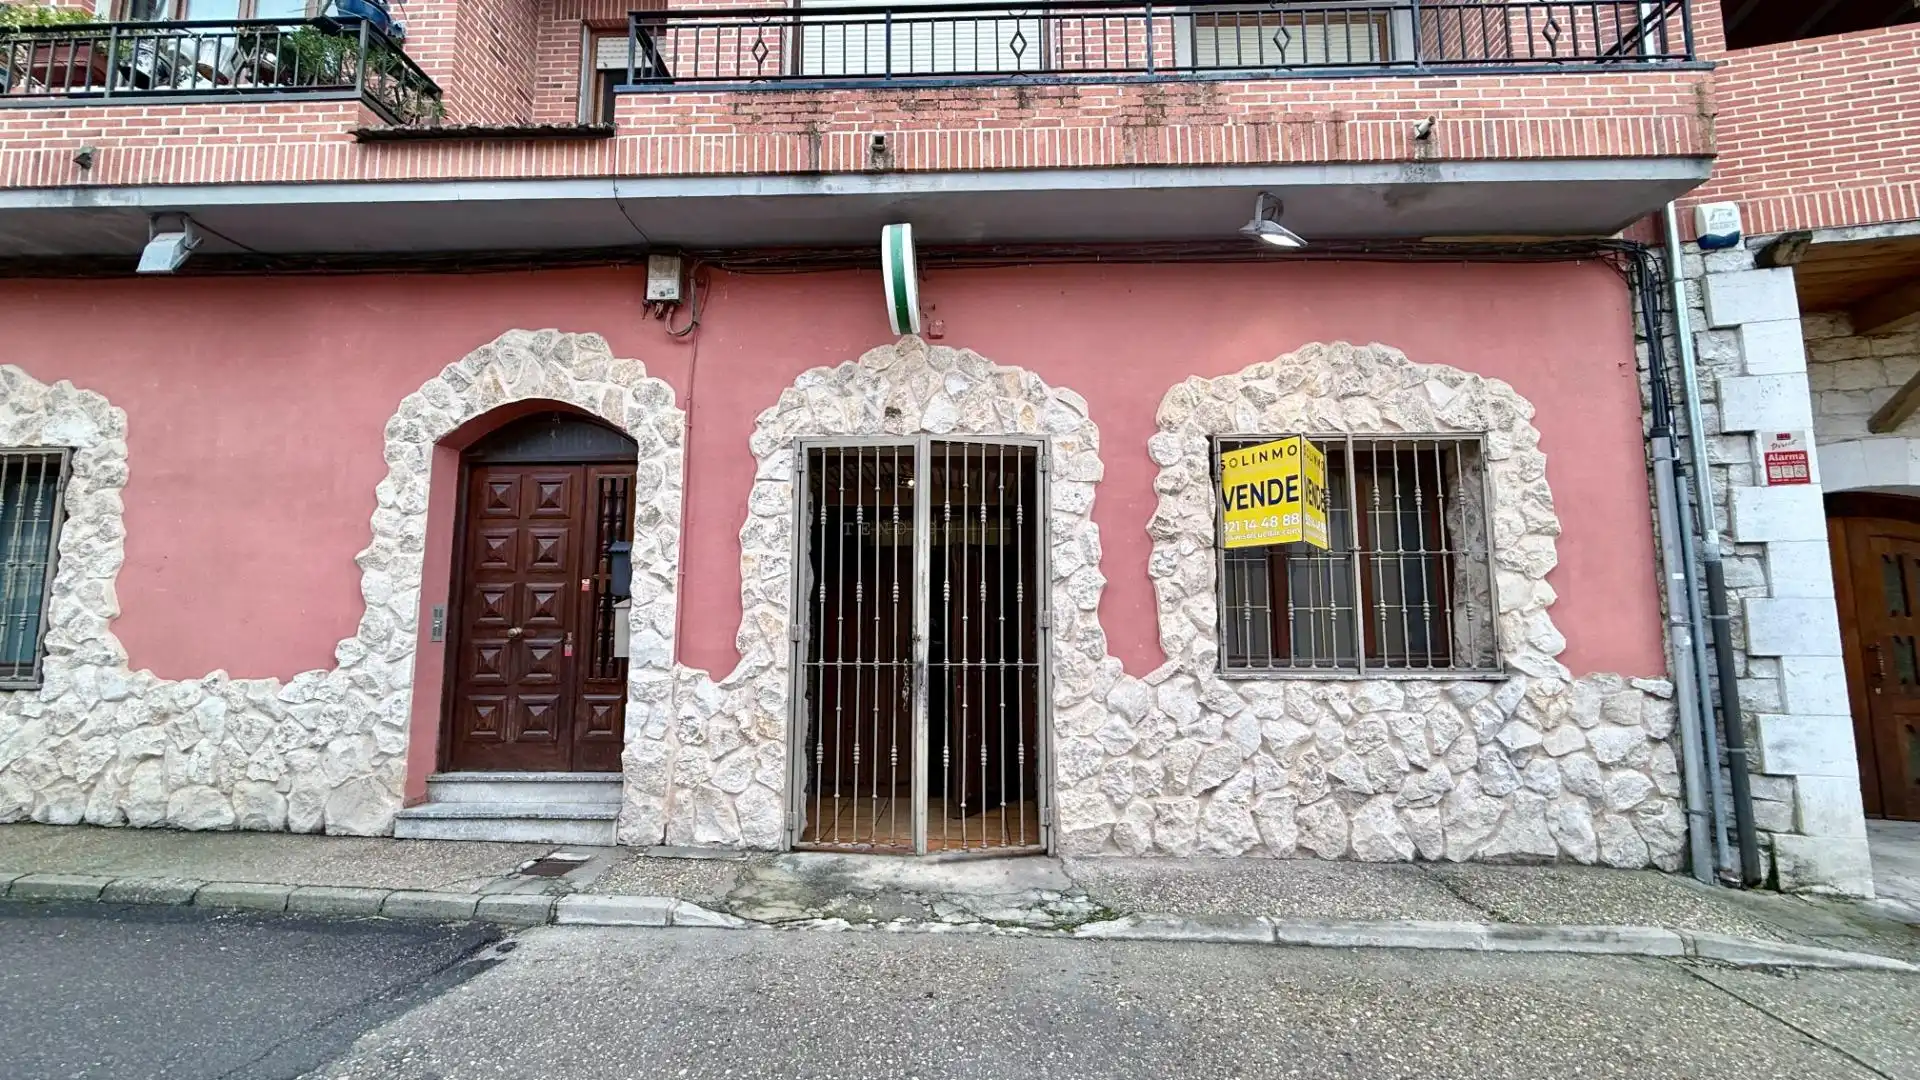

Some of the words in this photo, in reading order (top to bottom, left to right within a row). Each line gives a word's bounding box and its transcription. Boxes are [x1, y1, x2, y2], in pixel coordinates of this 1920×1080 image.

[1220, 444, 1298, 471] SOLINMO
[1768, 453, 1805, 461] Alarma
[1222, 474, 1299, 511] VENDE
[1243, 519, 1258, 531] 14
[1260, 515, 1279, 528] 48
[1282, 512, 1300, 526] 88
